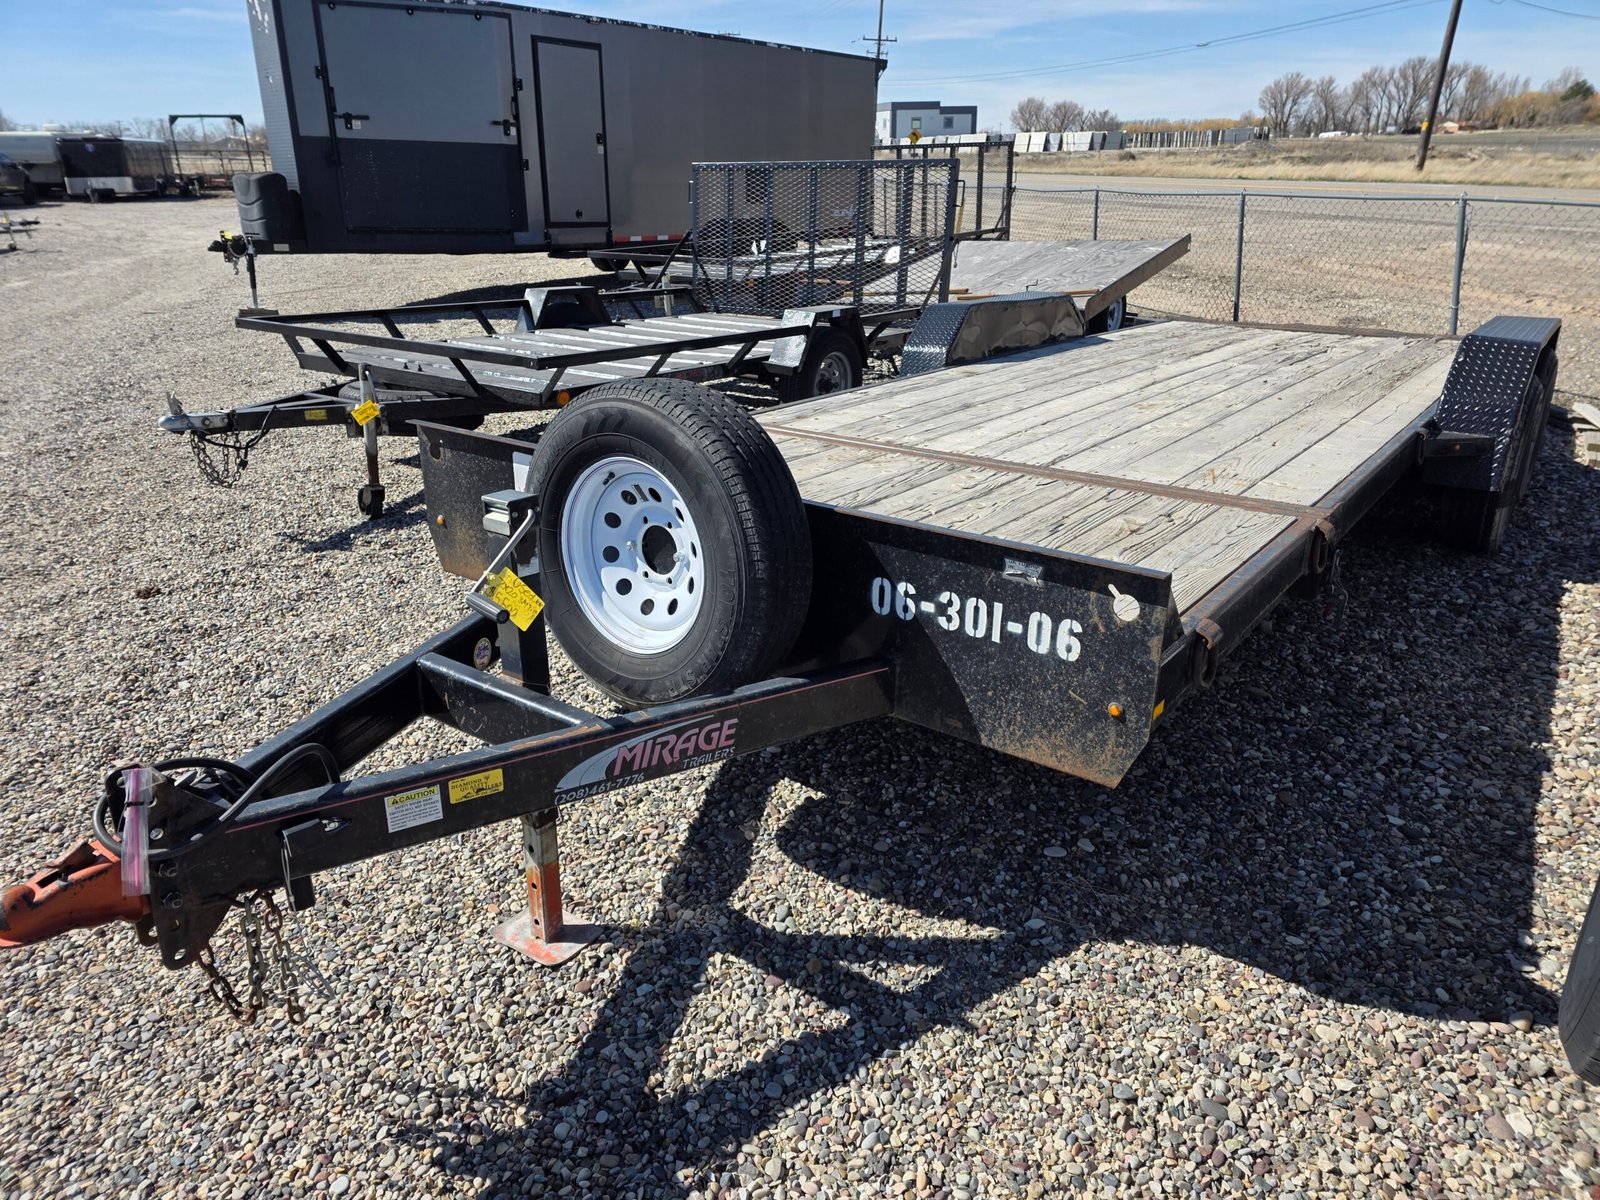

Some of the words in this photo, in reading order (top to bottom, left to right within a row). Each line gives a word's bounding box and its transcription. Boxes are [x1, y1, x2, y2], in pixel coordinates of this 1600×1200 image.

[871, 576, 1083, 662] 06-301-06
[613, 718, 739, 776] MIRAGE
[683, 746, 736, 769] TRAILERS
[399, 788, 435, 803] CAUTION
[554, 772, 645, 806] (208)461-7776
